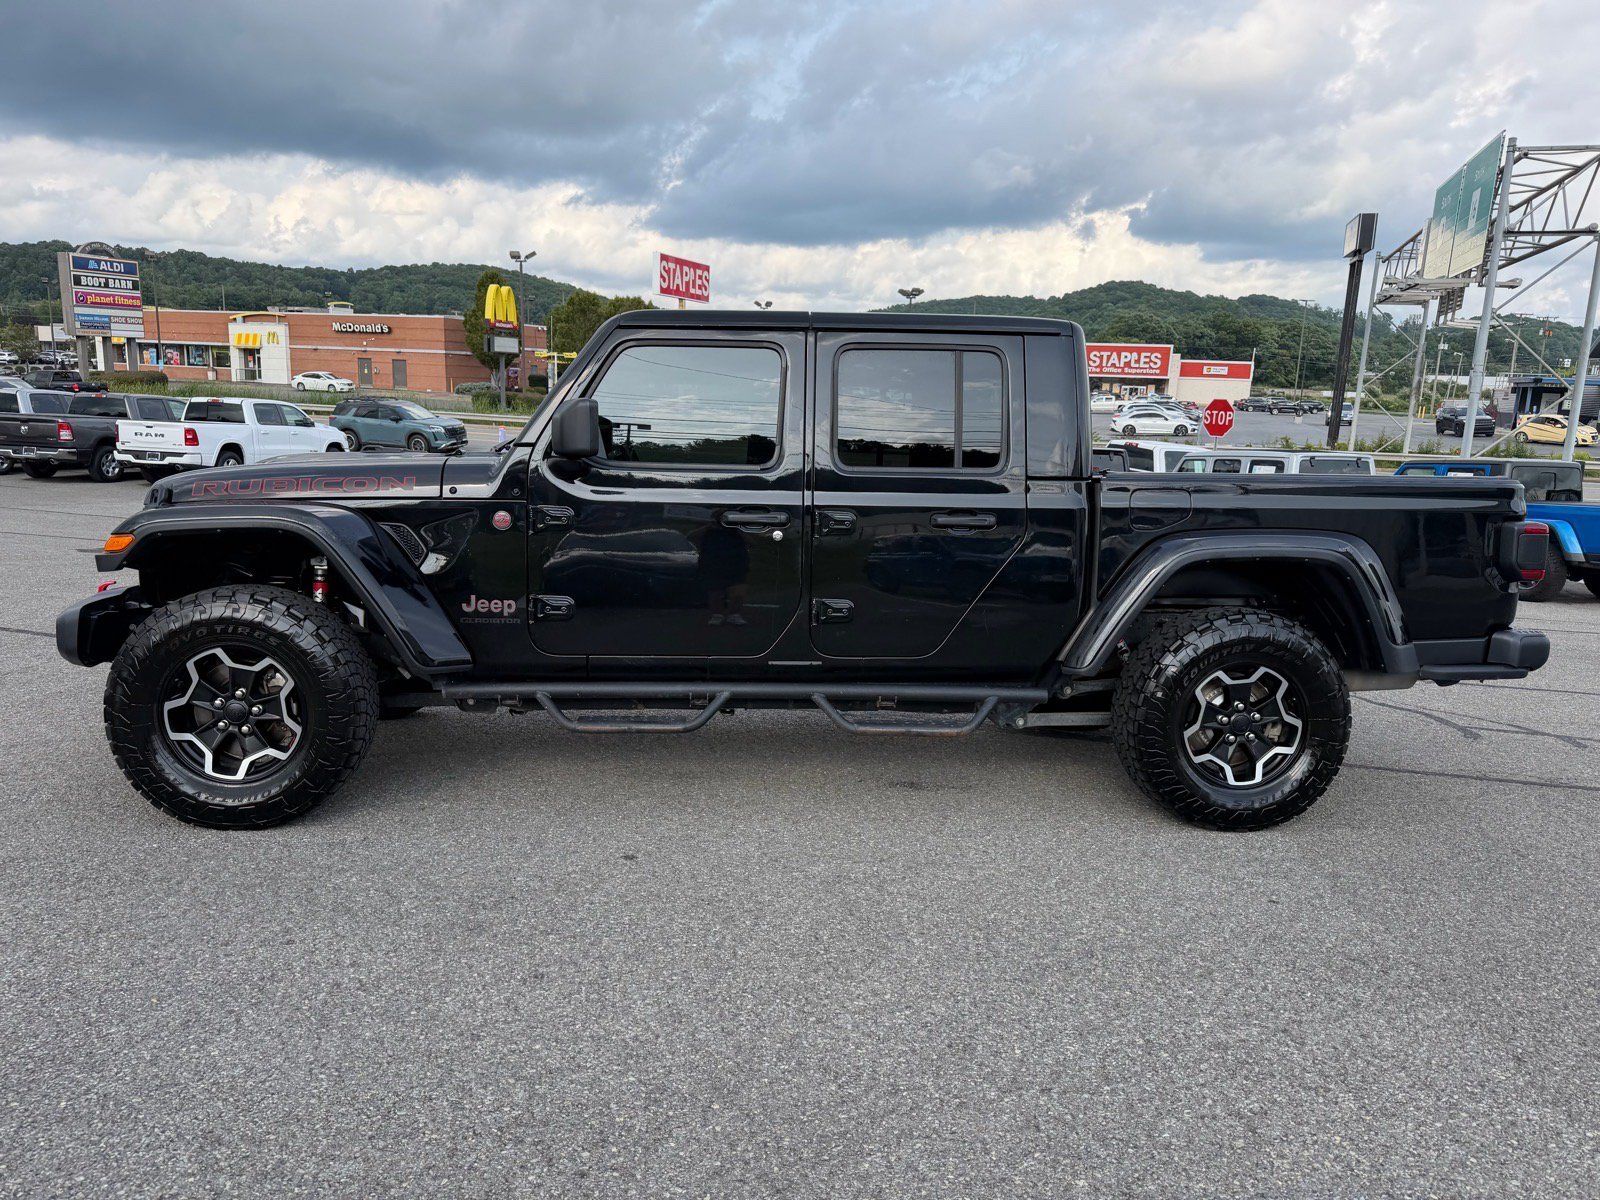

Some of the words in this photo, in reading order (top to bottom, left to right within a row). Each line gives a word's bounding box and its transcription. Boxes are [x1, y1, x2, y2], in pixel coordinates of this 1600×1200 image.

[100, 261, 124, 273] ALDI
[80, 276, 106, 287] BOOT
[108, 278, 133, 290] BARN
[660, 260, 709, 297] STAPLES
[86, 293, 114, 304] planet
[114, 295, 141, 306] fitness
[126, 317, 143, 325] SHOW
[332, 322, 389, 333] McDonald's
[1088, 351, 1162, 369] STAPLES
[1204, 410, 1233, 426] STOP
[191, 476, 417, 497] RUBICON
[461, 594, 517, 617] Jeep
